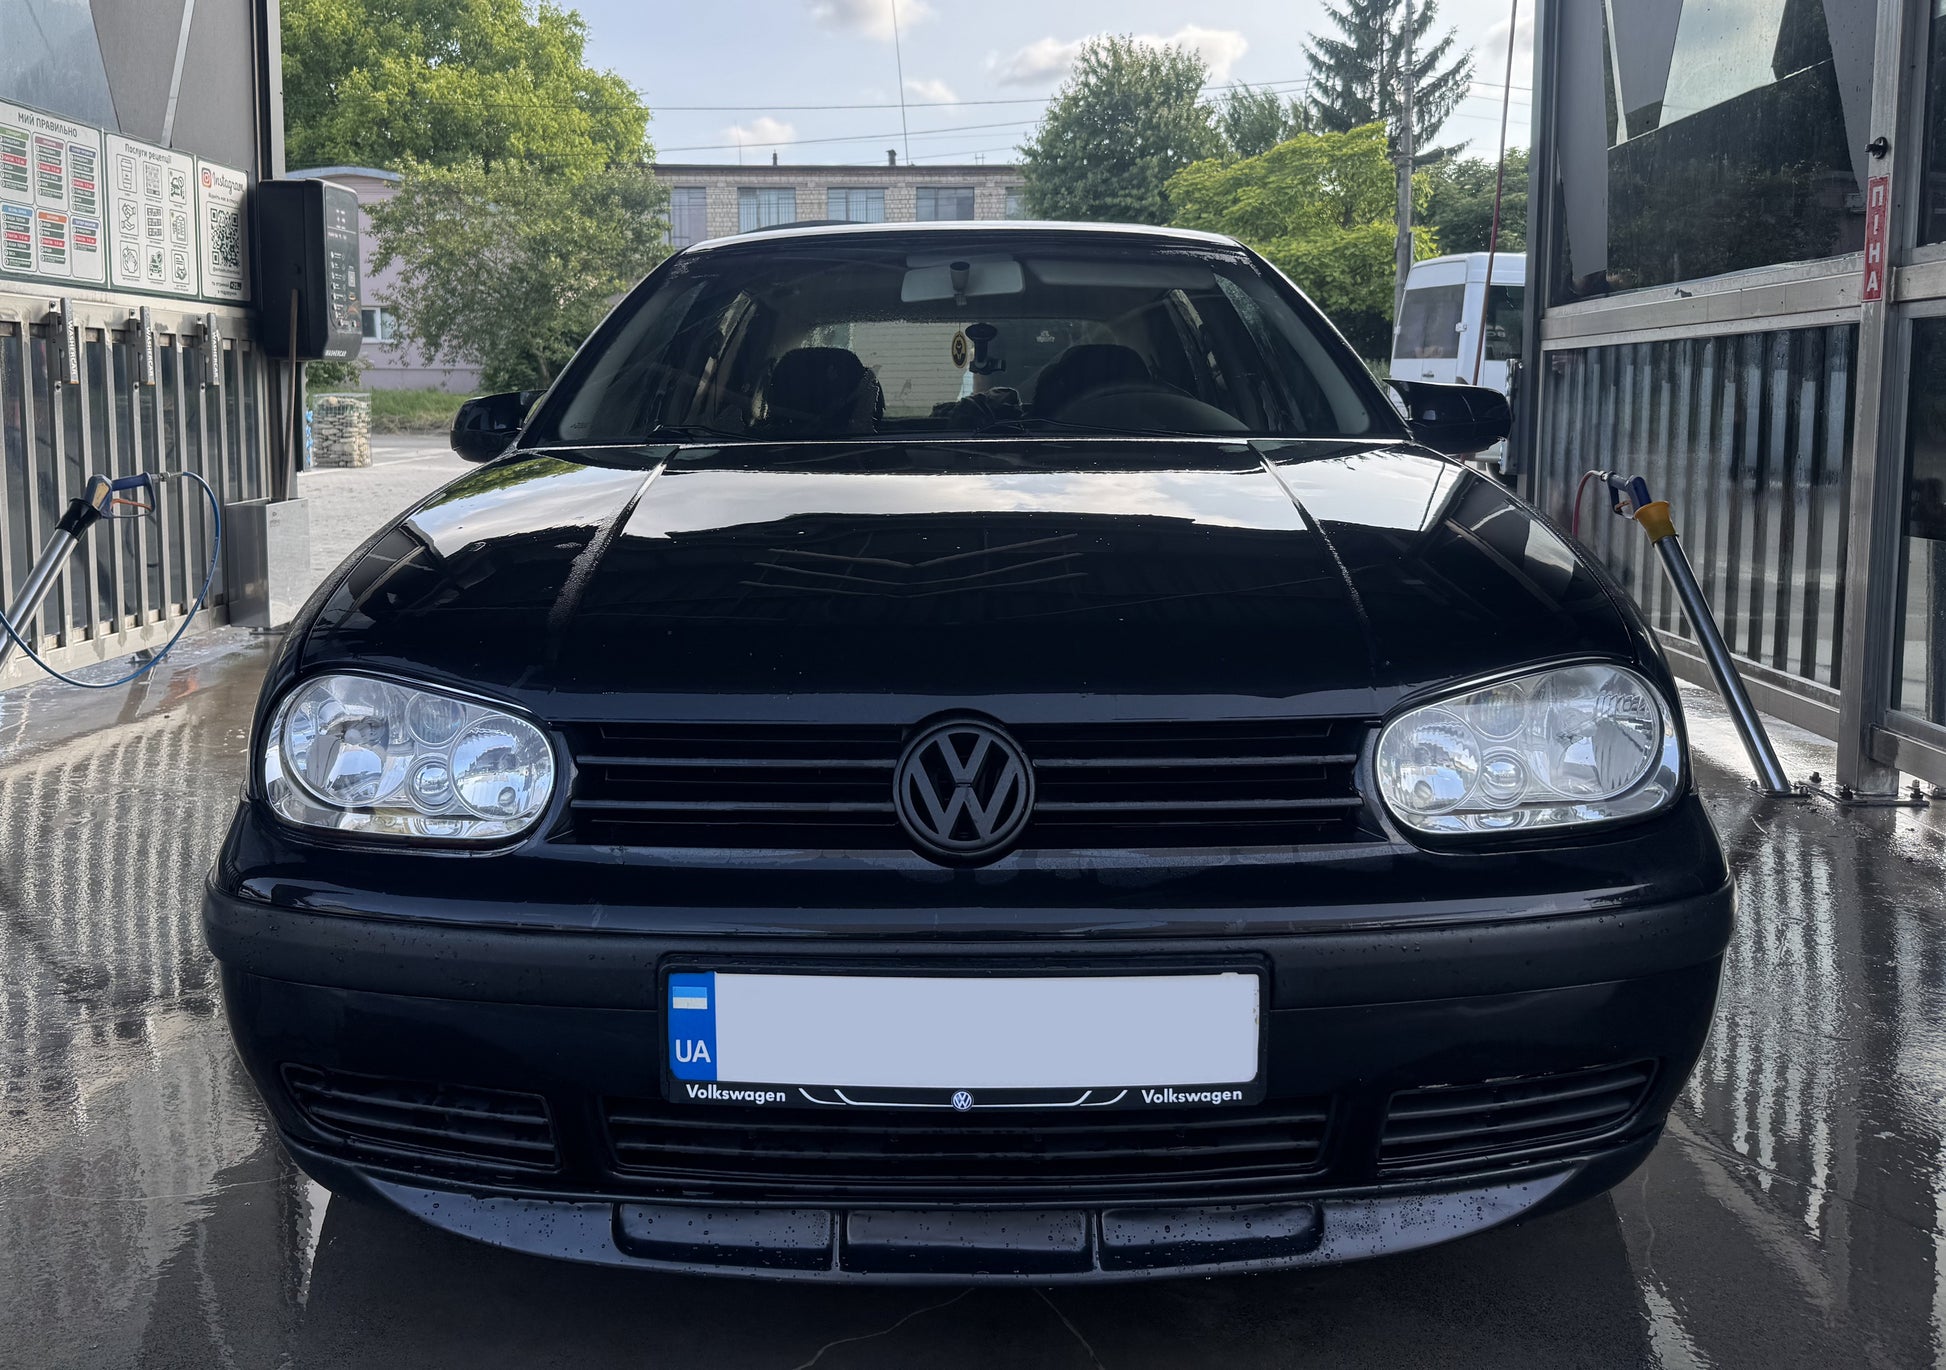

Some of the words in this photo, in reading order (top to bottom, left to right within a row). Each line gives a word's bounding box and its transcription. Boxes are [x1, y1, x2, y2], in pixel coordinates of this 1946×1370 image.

[17, 111, 35, 127] МИЙ
[36, 118, 78, 138] ПРАВИЛЬНО
[212, 171, 245, 196] Instagram
[1866, 184, 1884, 292] ПІНА
[675, 1039, 712, 1063] UA
[686, 1084, 786, 1104] Volkswagen
[1141, 1085, 1242, 1104] Volkswagen
